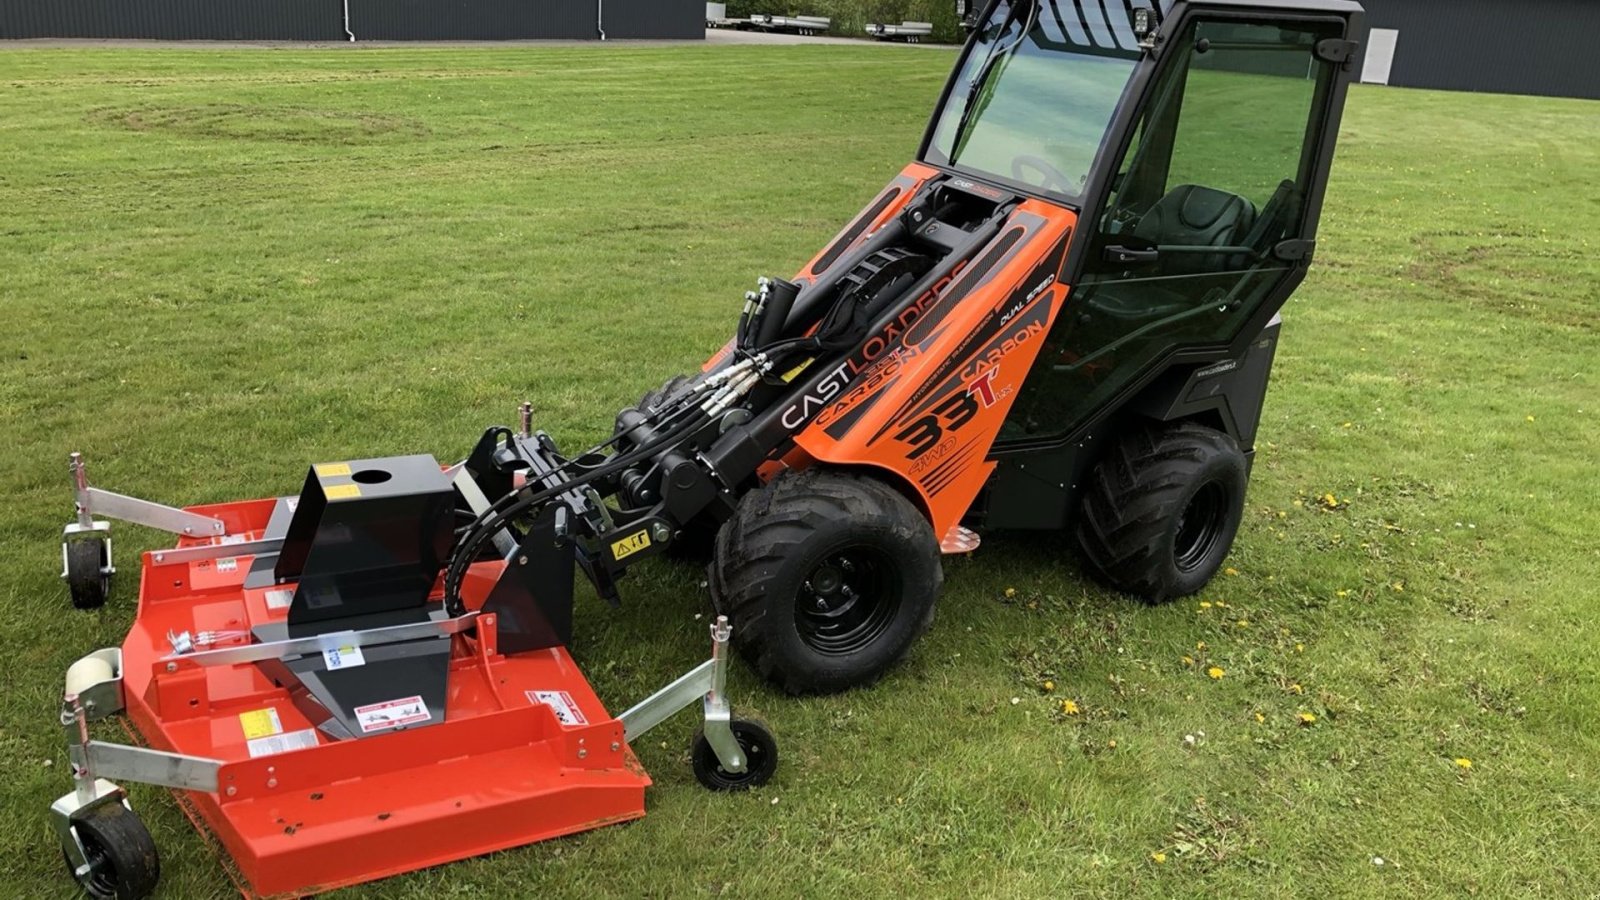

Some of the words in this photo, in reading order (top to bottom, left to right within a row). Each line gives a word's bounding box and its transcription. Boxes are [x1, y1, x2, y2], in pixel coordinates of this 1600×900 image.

[1000, 302, 1024, 326] DUAL
[1026, 274, 1055, 303] SPEED
[960, 319, 1044, 382] CARBON
[816, 348, 917, 426] CARBON
[908, 436, 957, 475] 4WD
